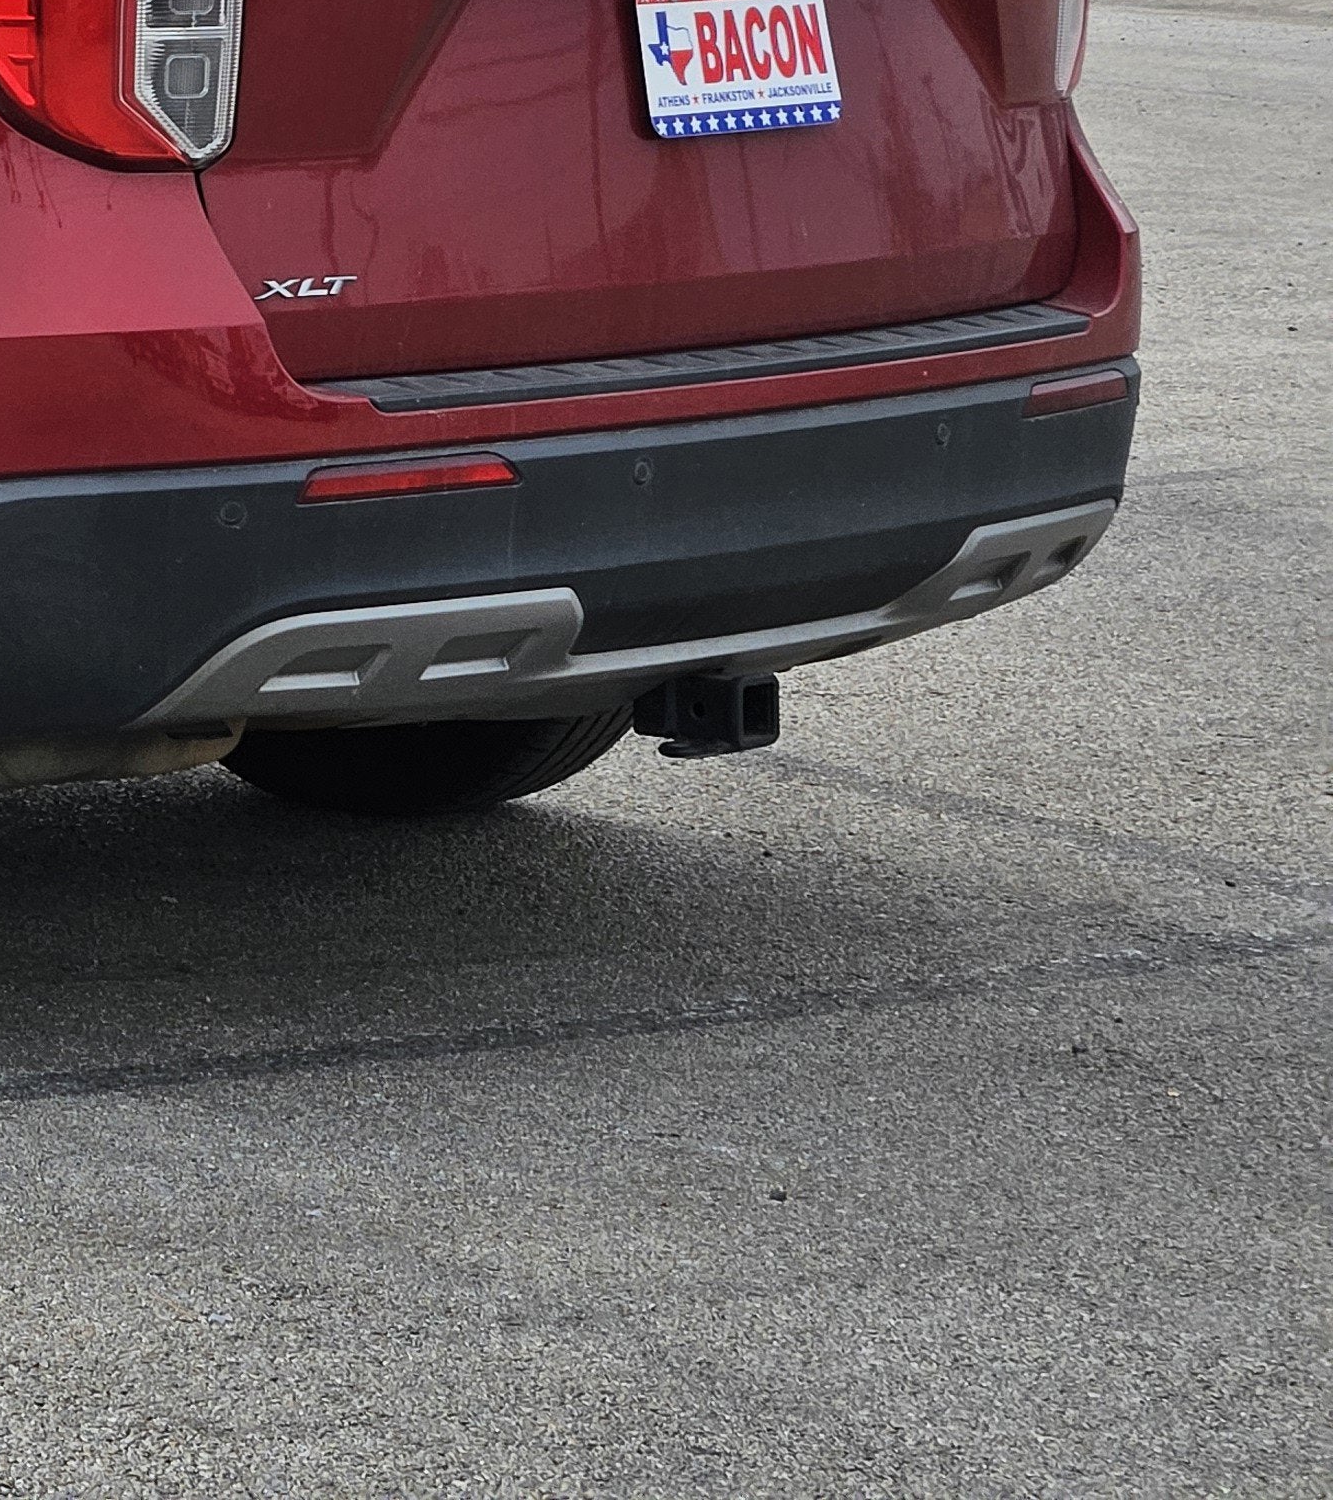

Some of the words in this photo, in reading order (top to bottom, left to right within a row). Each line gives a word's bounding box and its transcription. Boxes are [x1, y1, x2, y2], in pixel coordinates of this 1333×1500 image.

[694, 2, 828, 85] BACON
[657, 94, 691, 108] ATHENS
[701, 89, 755, 105] FRANKSTON
[766, 81, 833, 98] JACKSONVILLE
[253, 275, 358, 301] XLT
